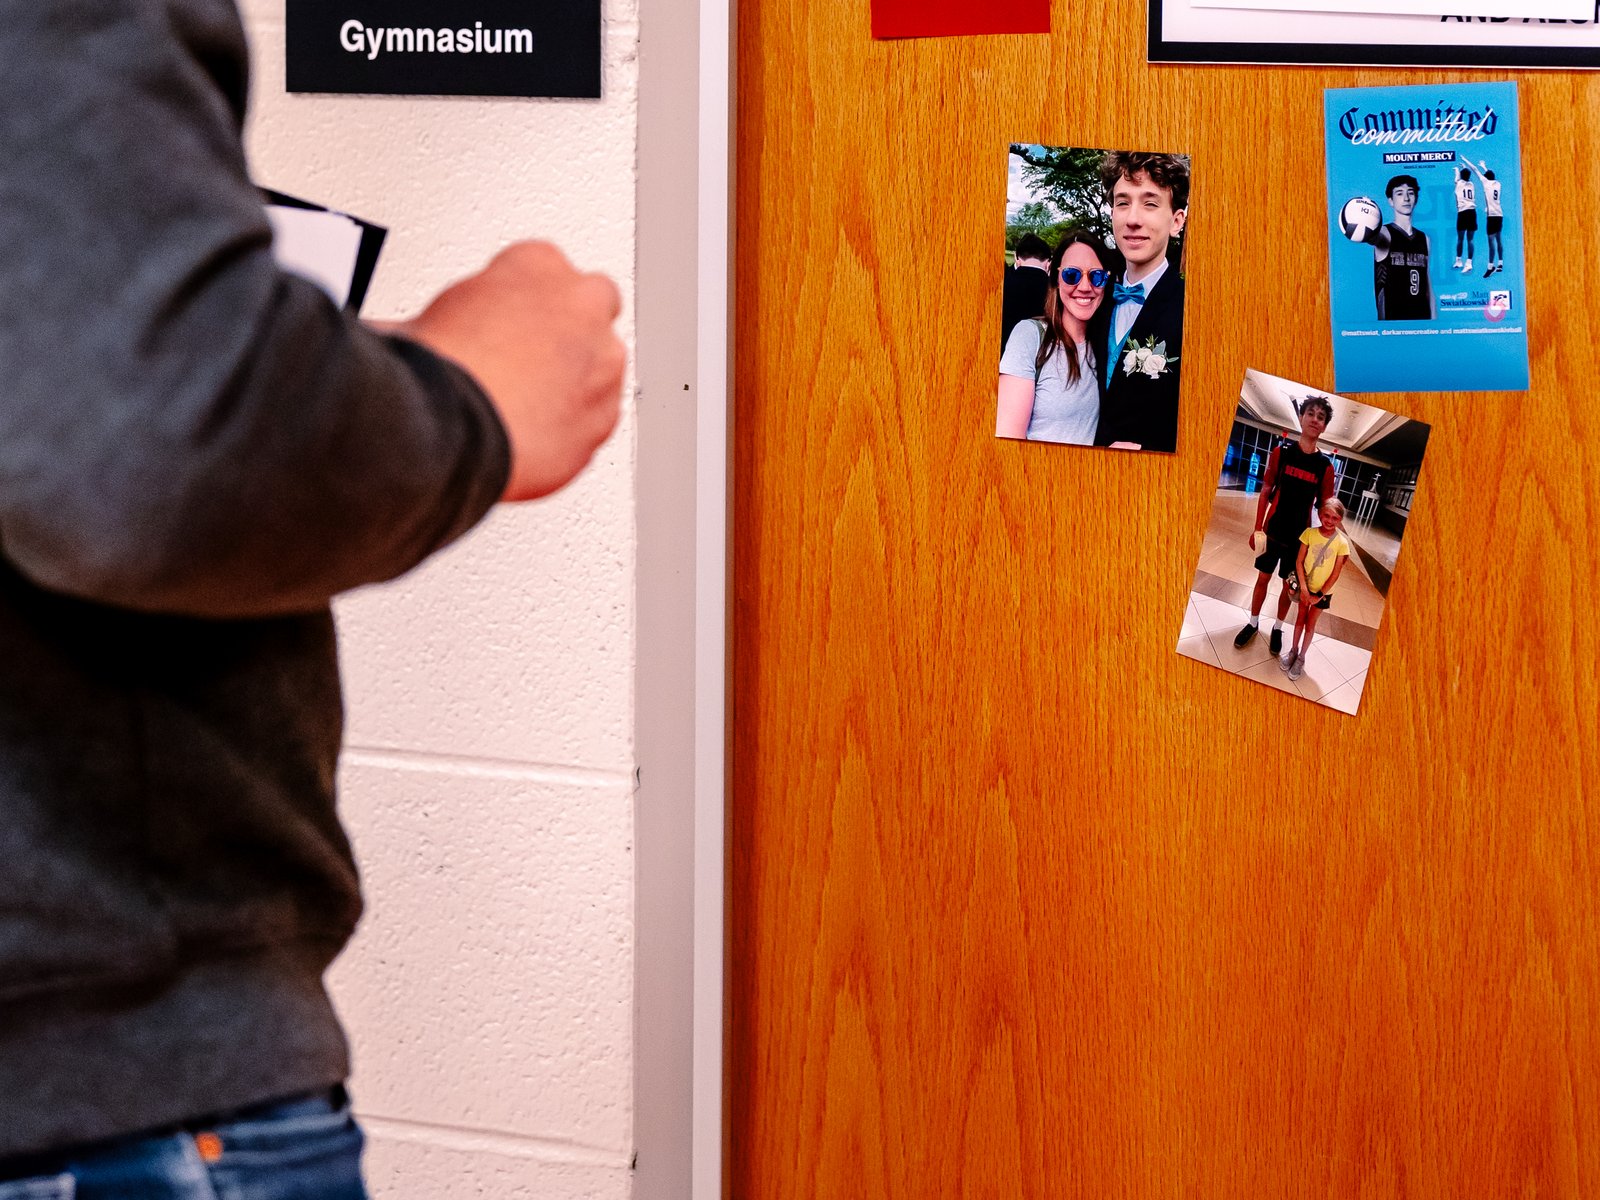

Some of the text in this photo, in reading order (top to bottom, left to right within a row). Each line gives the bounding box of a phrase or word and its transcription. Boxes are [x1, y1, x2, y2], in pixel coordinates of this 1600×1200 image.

[339, 19, 534, 60] Gymnasium
[1338, 100, 1499, 140] Committed
[1351, 108, 1494, 146] committed
[1385, 152, 1453, 162] MOUNT MERCY
[1462, 189, 1473, 200] 10
[1493, 189, 1499, 201] 9
[1409, 269, 1420, 296] 9
